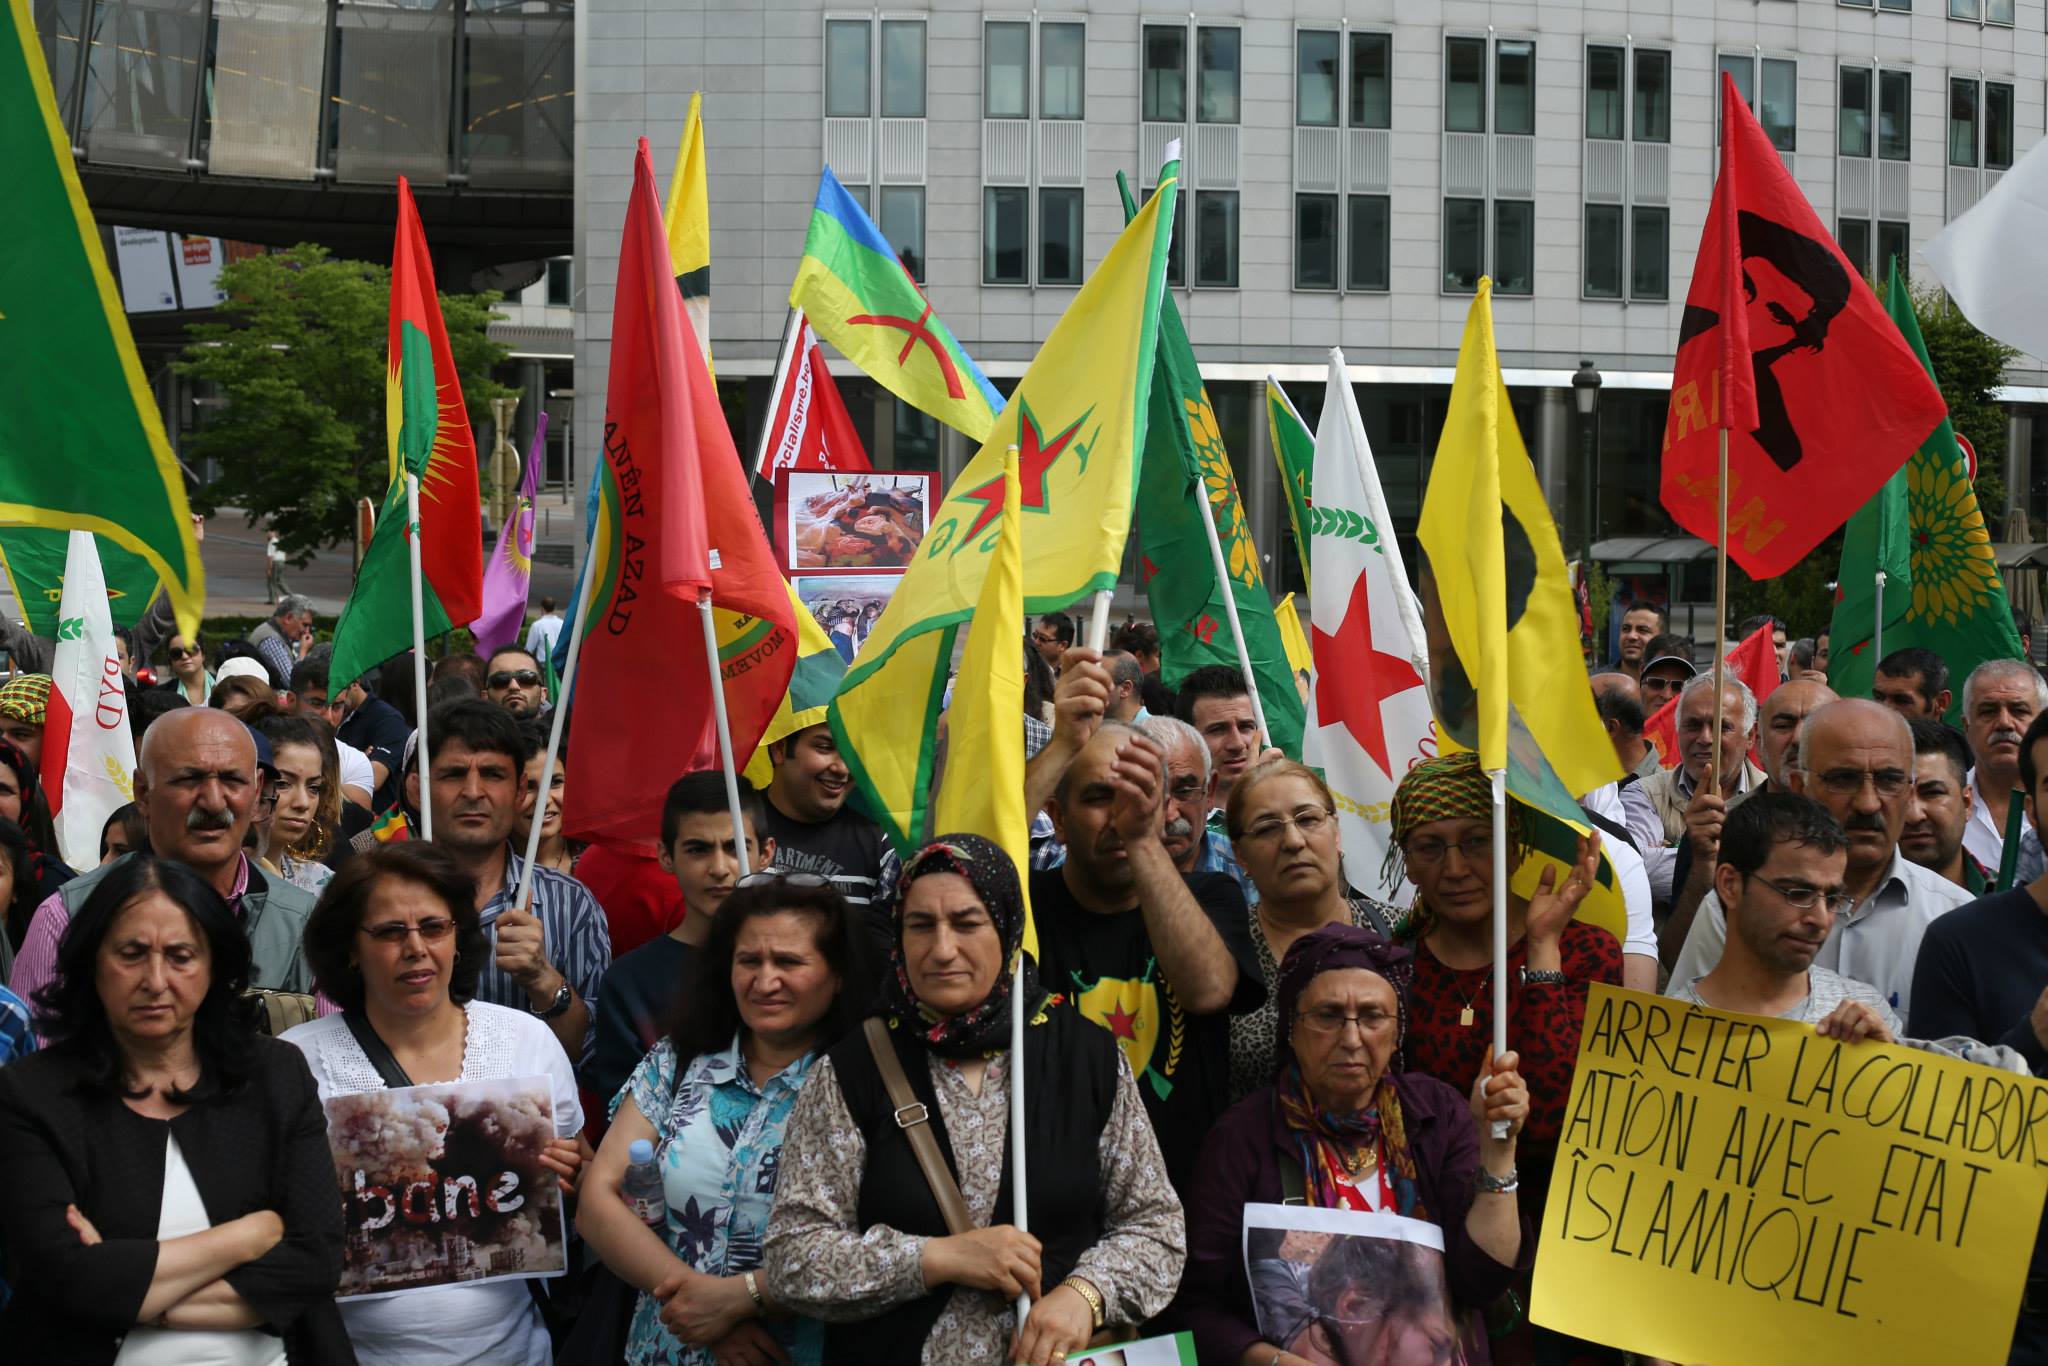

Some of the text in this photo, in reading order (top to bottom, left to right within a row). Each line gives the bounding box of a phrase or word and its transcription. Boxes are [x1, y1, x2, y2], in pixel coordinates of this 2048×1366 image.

[779, 363, 811, 468] ocialisme.be
[603, 421, 646, 637] ANÊN AZAD
[775, 846, 845, 875] ARTMENT
[353, 1168, 525, 1230] bane
[1715, 1106, 1840, 1205] AVEC
[1871, 1144, 1992, 1248] ETAT
